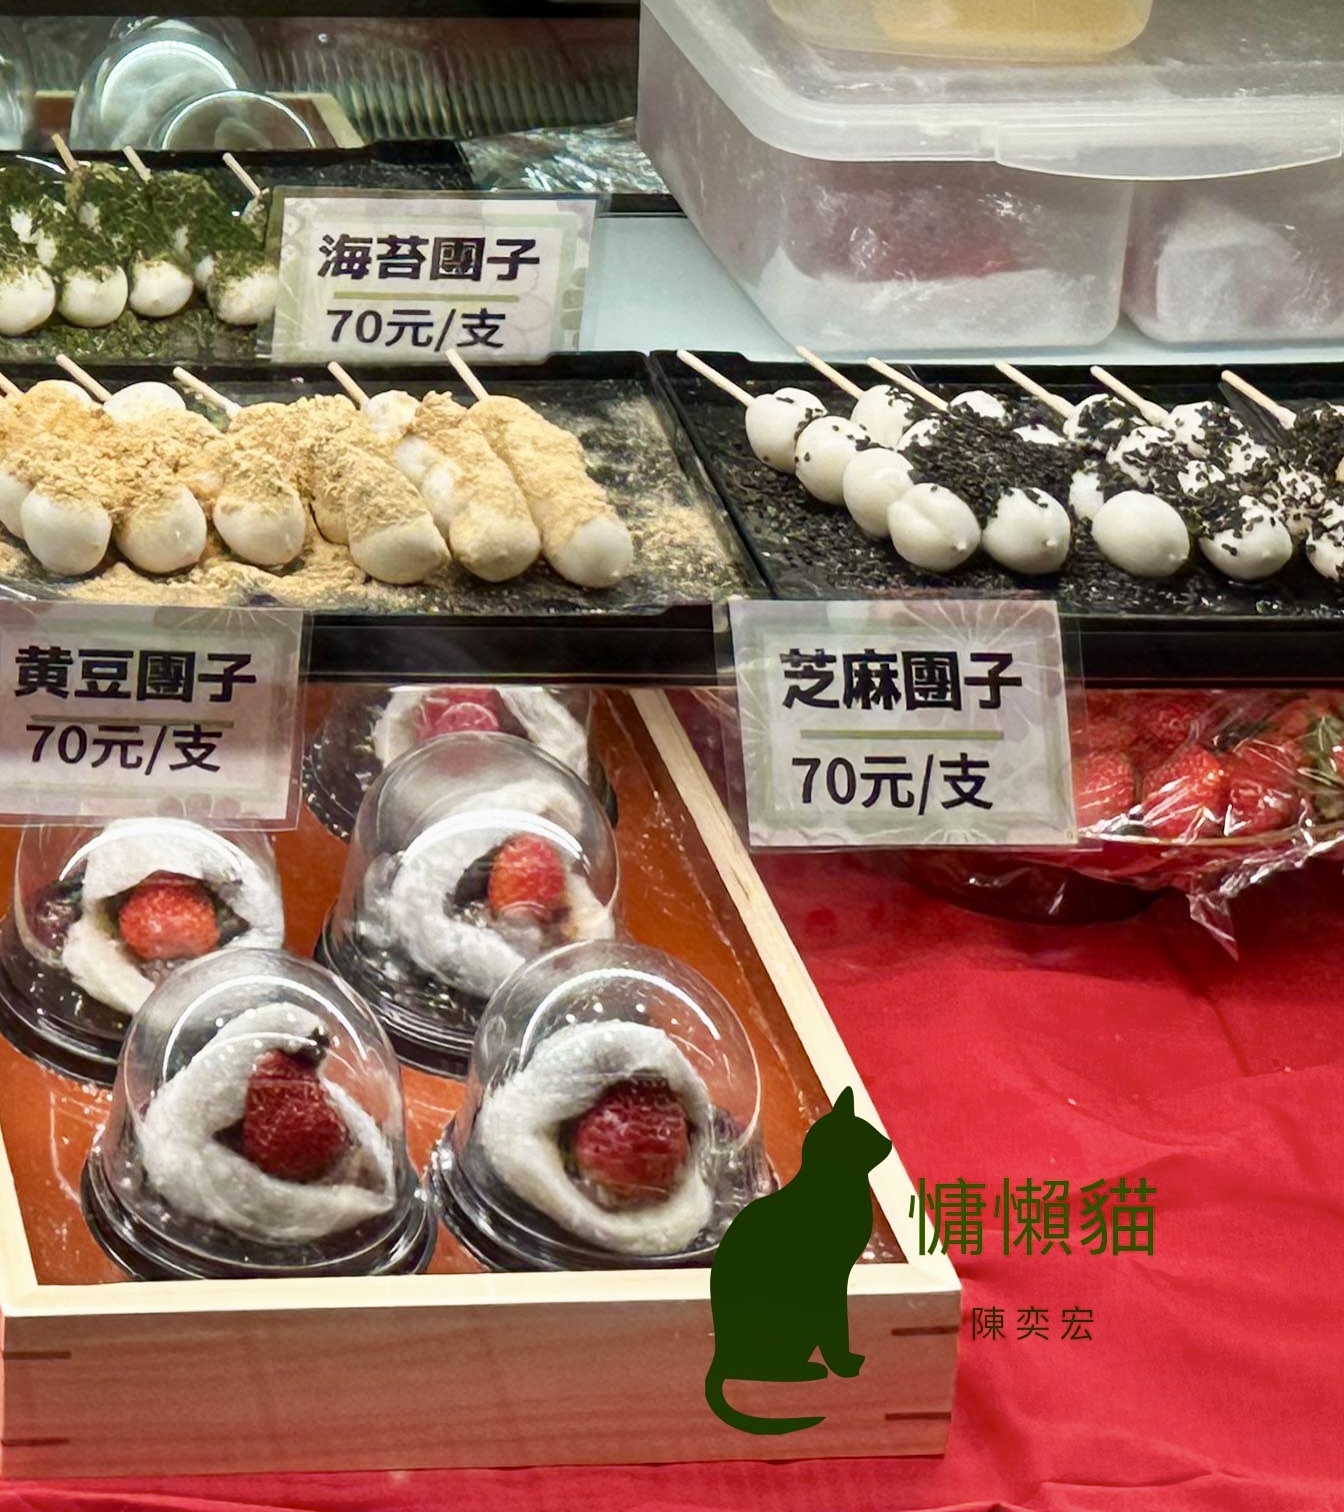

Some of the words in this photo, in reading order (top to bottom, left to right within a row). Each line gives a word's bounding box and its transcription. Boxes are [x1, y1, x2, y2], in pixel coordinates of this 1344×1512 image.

[317, 233, 540, 282] 海苔團子
[326, 307, 506, 352] 70元/支
[779, 648, 1023, 711] 芝麻團子
[25, 723, 223, 776] 70元/支
[792, 752, 994, 816] 70元/支
